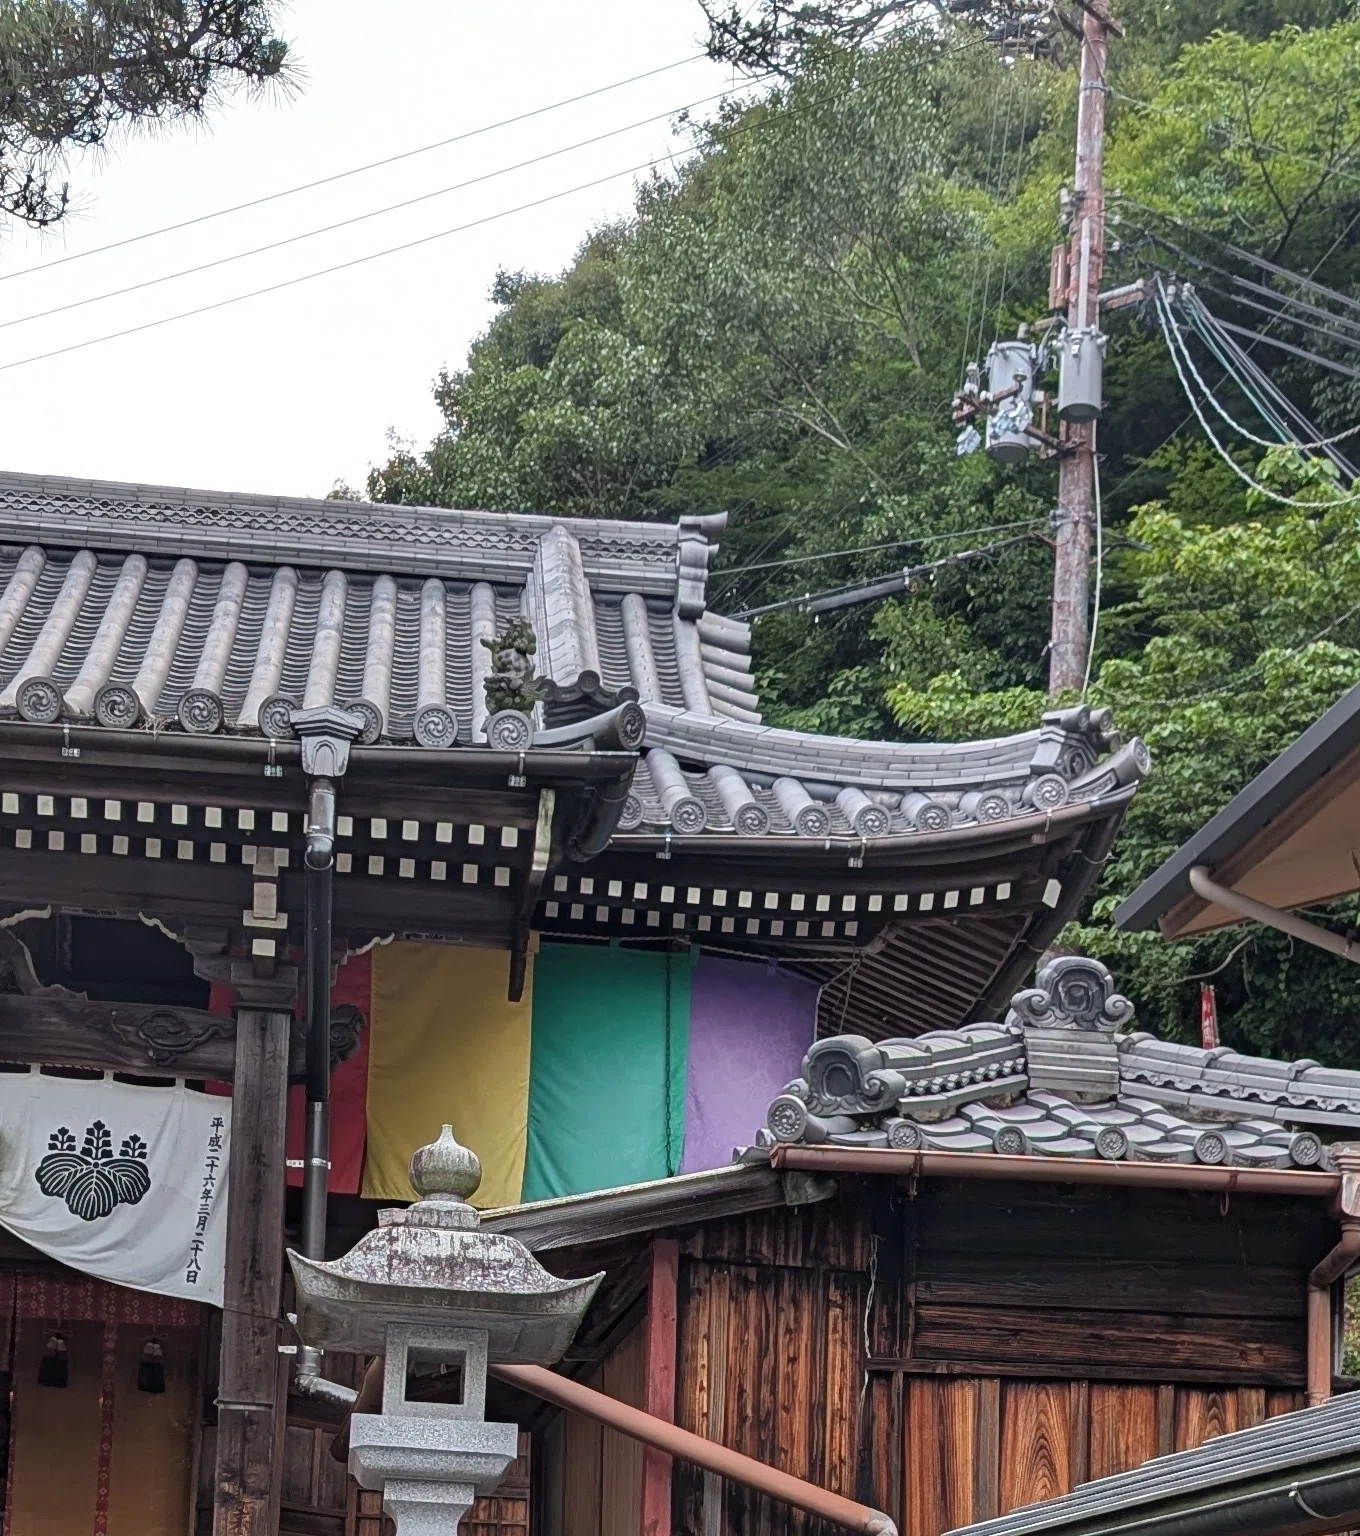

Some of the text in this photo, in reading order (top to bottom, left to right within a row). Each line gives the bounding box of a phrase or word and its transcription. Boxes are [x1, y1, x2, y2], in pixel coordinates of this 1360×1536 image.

[186, 1116, 225, 1284] 平成二十六年三月二十八日
